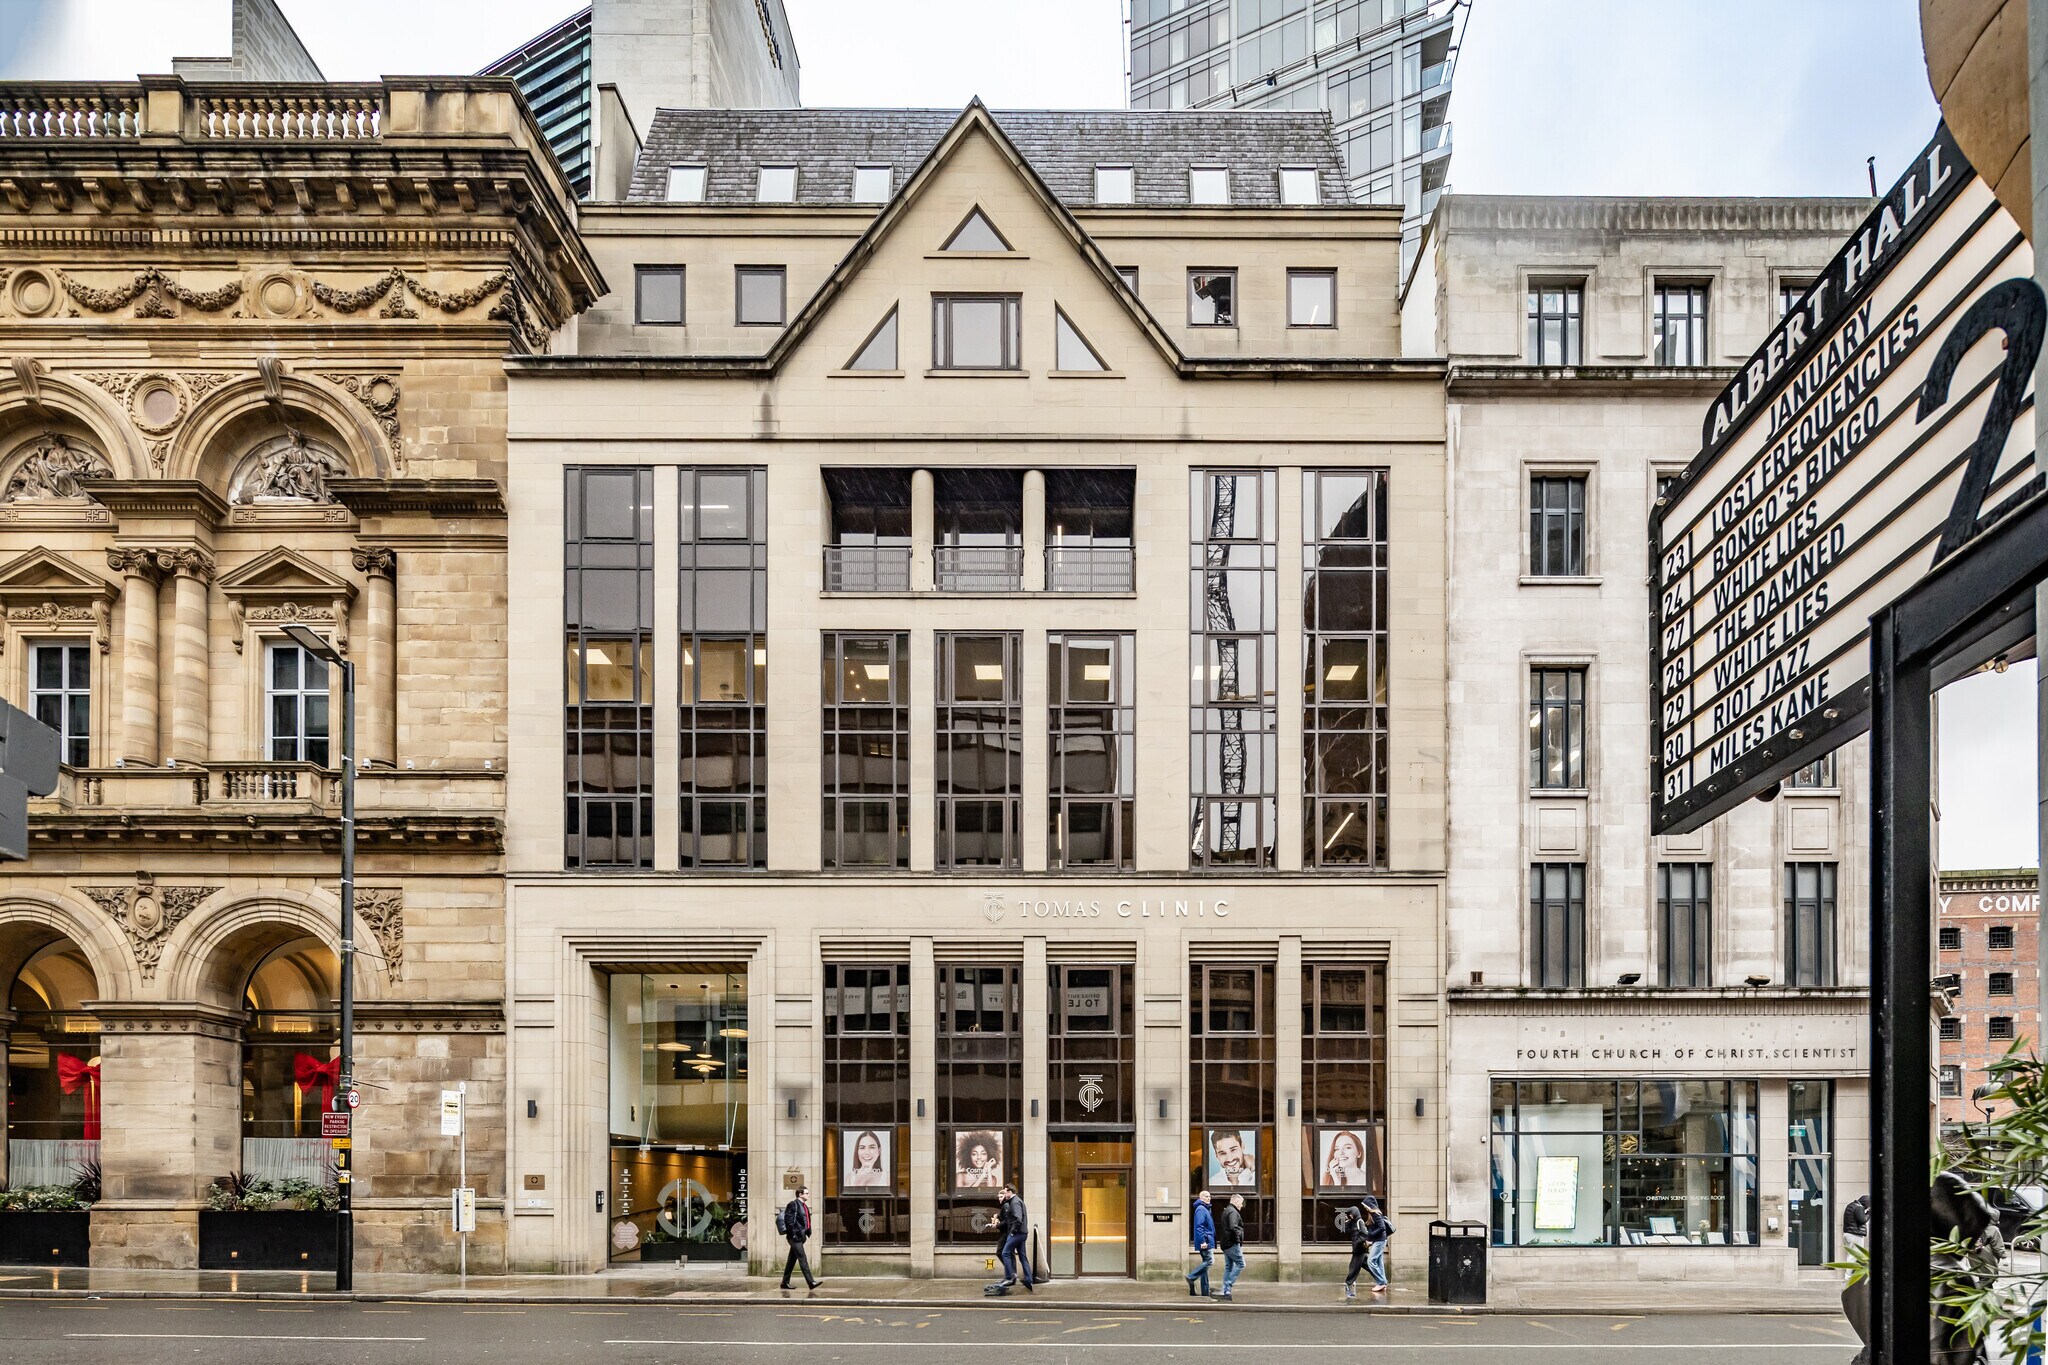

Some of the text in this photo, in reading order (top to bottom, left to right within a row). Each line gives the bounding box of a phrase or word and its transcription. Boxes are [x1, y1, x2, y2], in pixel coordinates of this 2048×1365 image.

[1710, 144, 1951, 445] ALBERT HALL
[1666, 304, 1919, 581] 23 LOST FREQUENCIES
[1765, 296, 1873, 442] JANUARY
[1665, 395, 1879, 621] 24 BONGO'S BINGO
[1666, 500, 1818, 655] 27 WHITE LIES
[1666, 522, 1845, 695] 28 THE DAMNED
[1666, 581, 1829, 729] 29 WHITE LIES
[1666, 637, 1811, 765] 30 RIOT JAZZ
[1667, 668, 1830, 800] 31 MILES KANE
[1018, 900, 1229, 918] TOMAS CLINIC
[1516, 1049, 1579, 1059] FOURTH
[1591, 1049, 1661, 1059] CHURCH
[1674, 1049, 1694, 1059] OF
[1773, 1049, 1856, 1059] SCIENTIST
